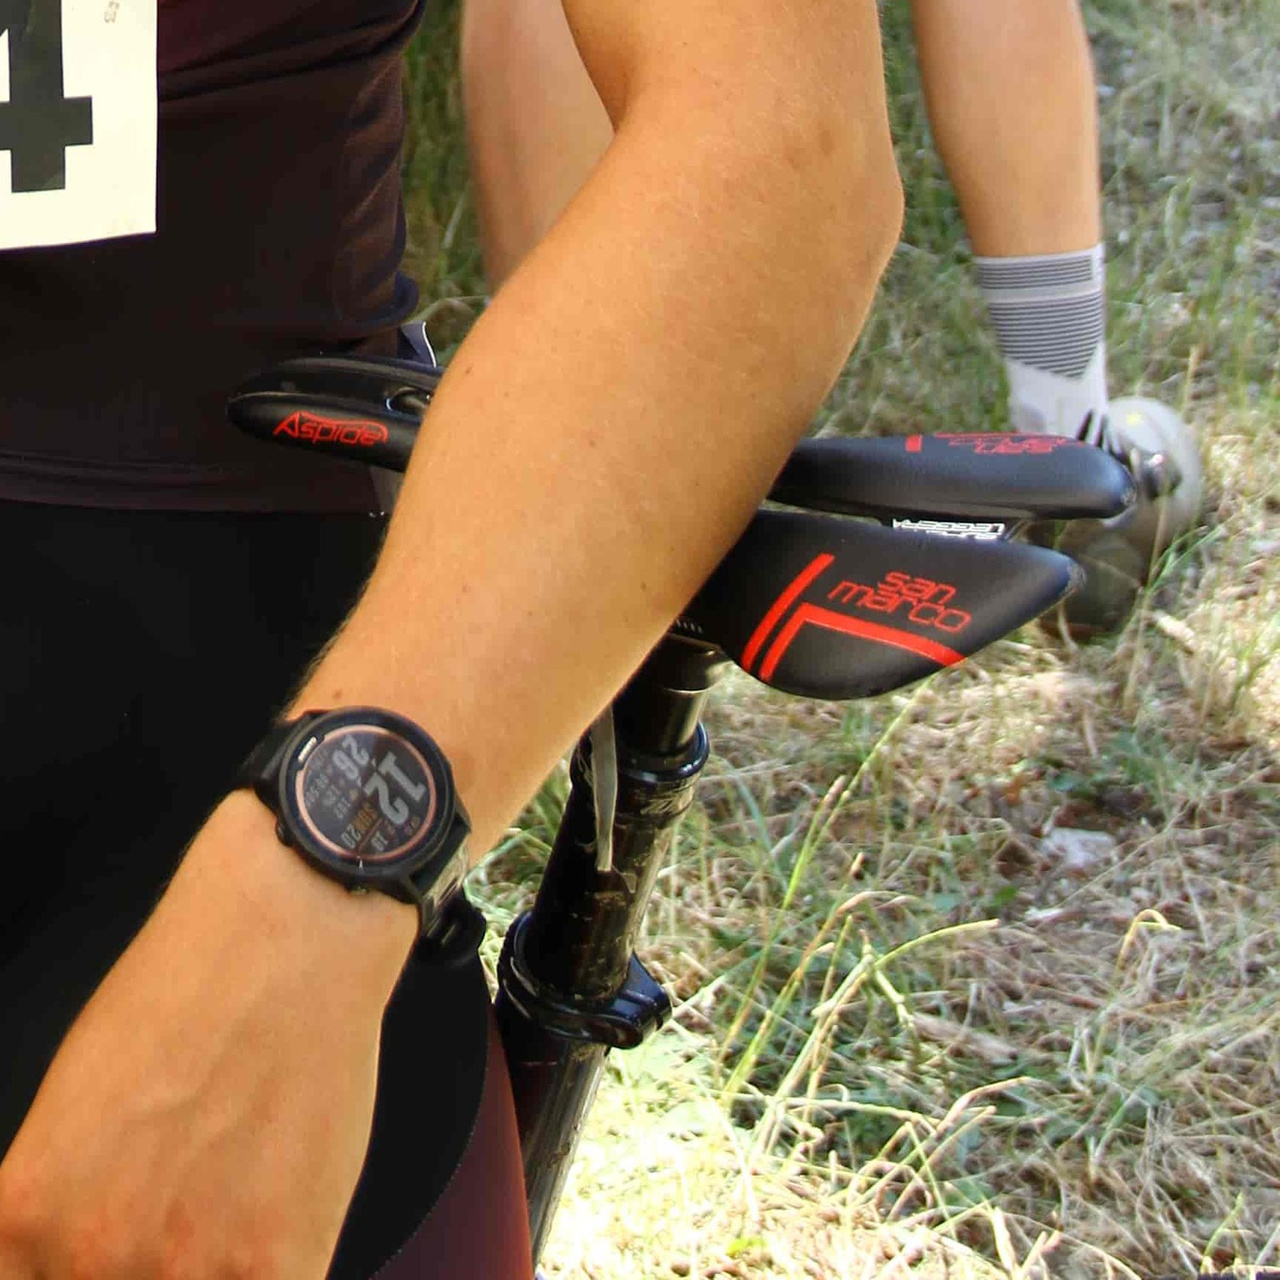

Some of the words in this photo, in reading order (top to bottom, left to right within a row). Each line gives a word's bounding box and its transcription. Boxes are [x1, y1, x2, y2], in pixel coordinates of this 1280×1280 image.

[825, 580, 973, 634] marco
[876, 570, 958, 606] san
[332, 734, 370, 780] 26
[363, 751, 427, 826] 12
